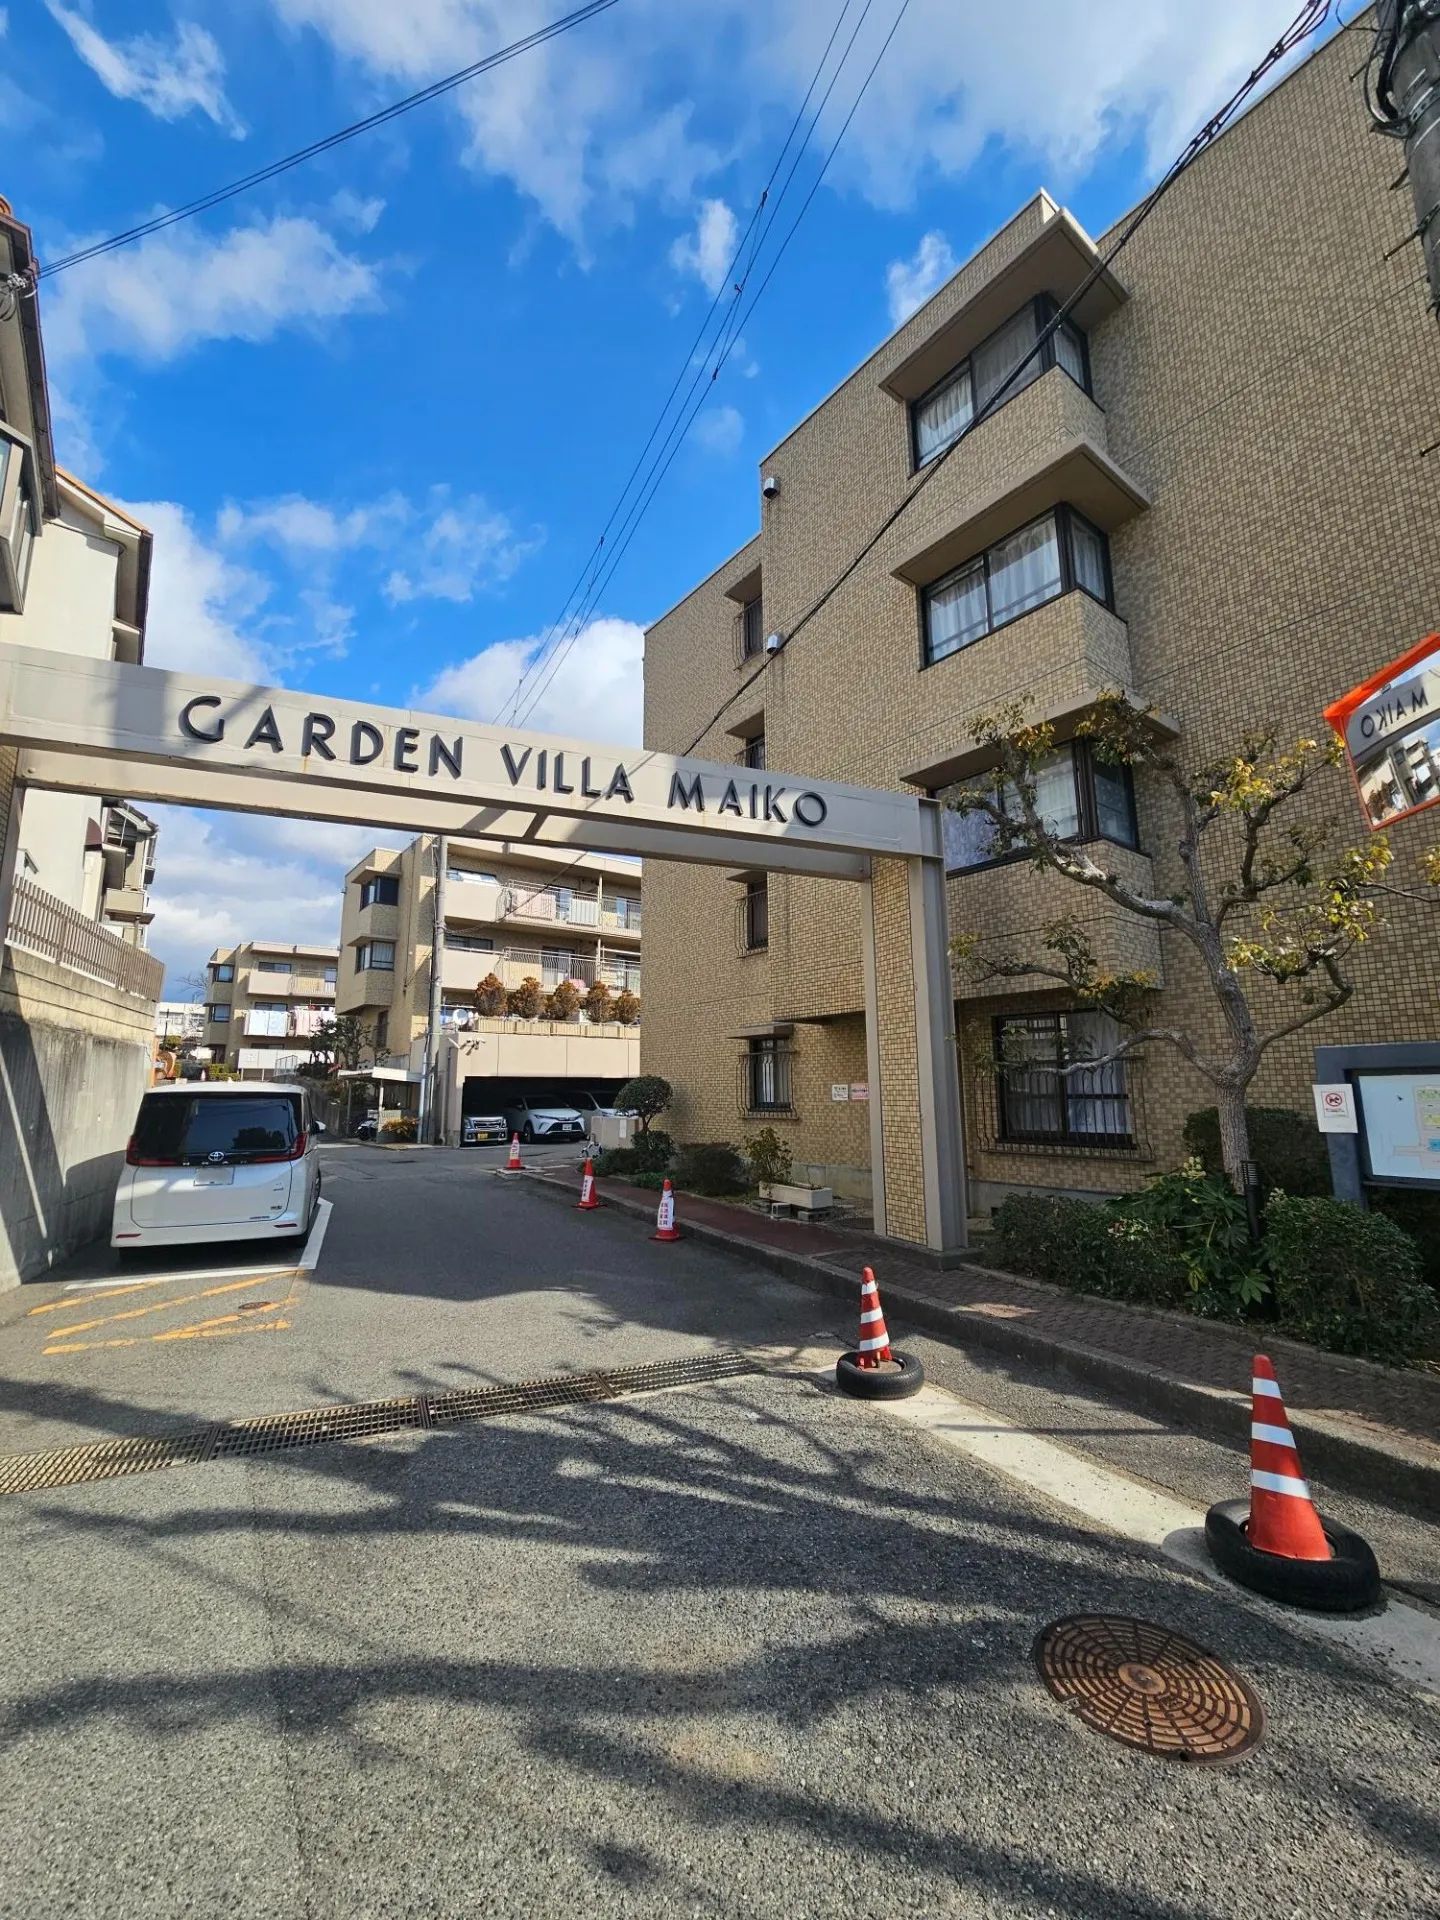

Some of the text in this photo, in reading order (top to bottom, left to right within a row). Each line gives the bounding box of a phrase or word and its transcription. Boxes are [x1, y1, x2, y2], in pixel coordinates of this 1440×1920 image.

[178, 695, 828, 827] GARDEN VILLA MAIKO
